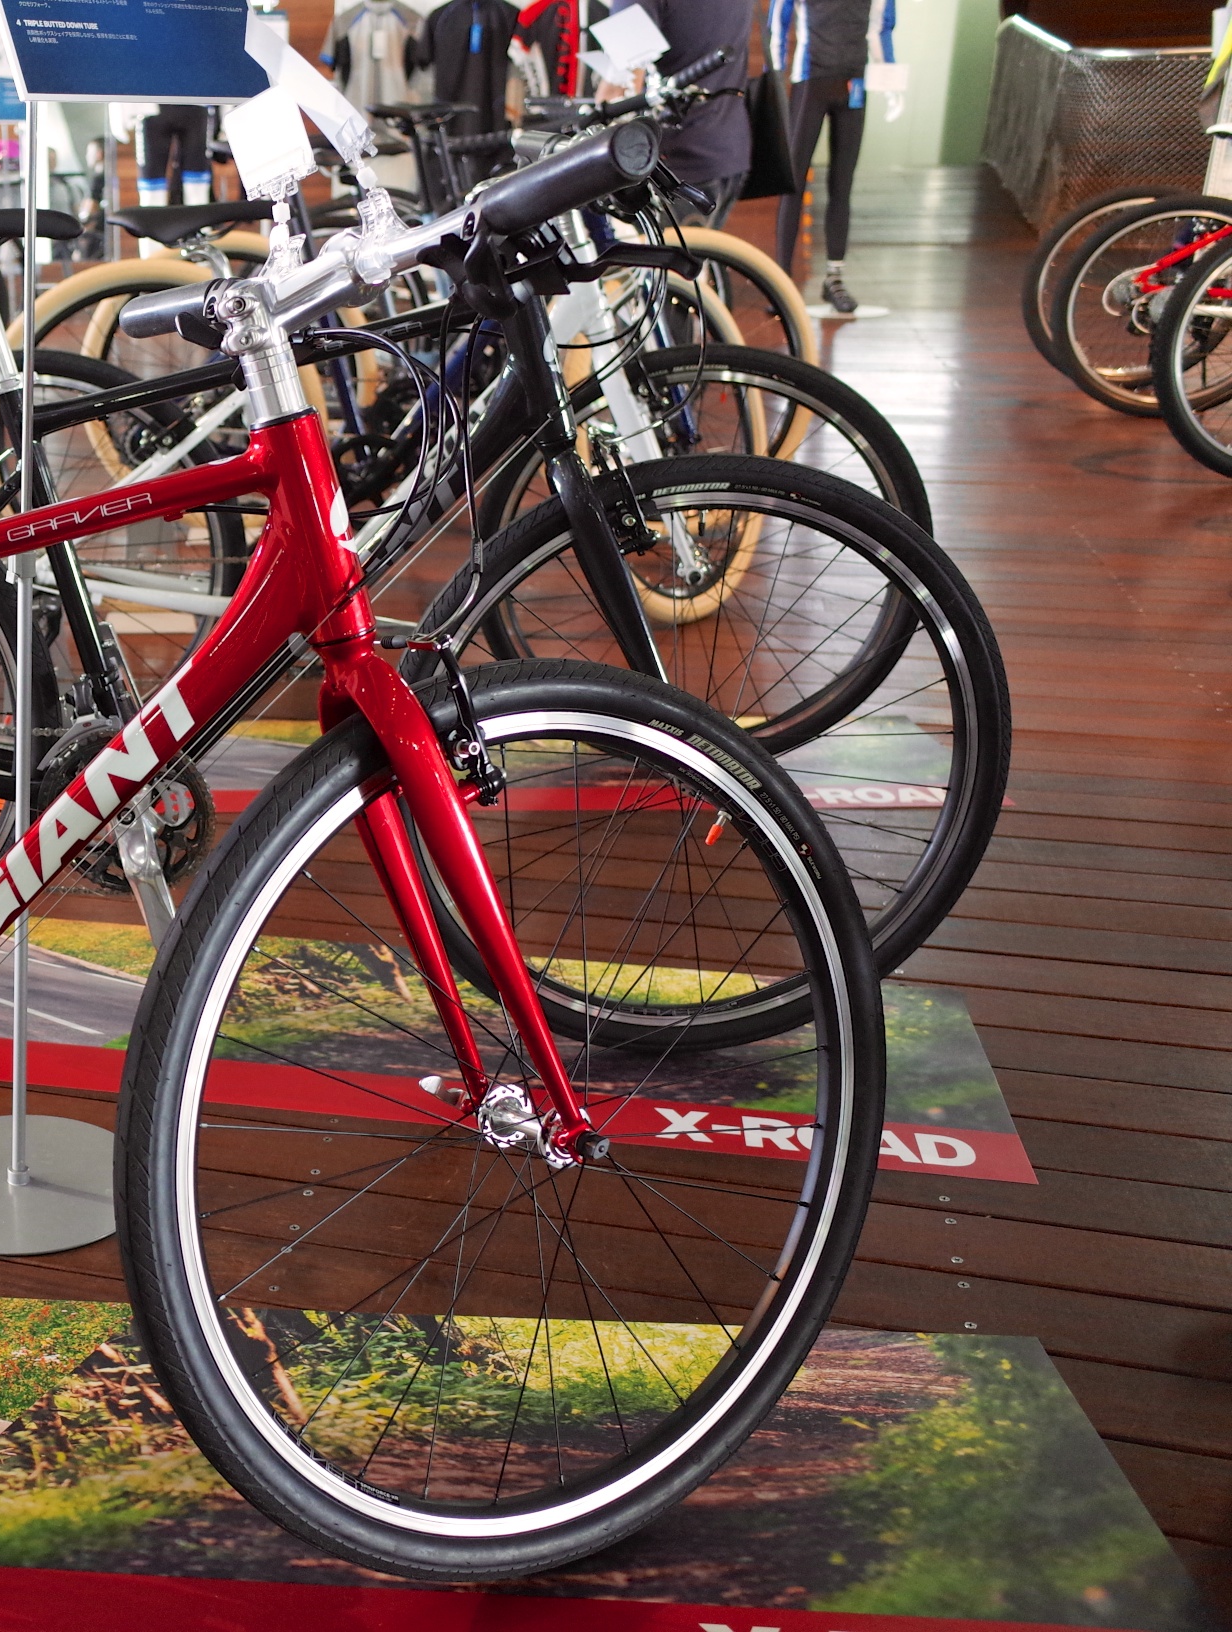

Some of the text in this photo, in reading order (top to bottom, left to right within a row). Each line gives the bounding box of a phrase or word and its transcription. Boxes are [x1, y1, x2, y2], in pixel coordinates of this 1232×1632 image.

[23, 19, 43, 27] TRIPLE
[44, 20, 66, 29] BUTTED
[66, 21, 84, 29] DOWN
[84, 22, 99, 30] TUBE
[652, 481, 731, 497] DETONATOR
[6, 492, 153, 542] GRAVIER
[647, 719, 685, 737] MAXXIS
[686, 733, 763, 791] DETONATOR
[784, 821, 796, 834] MAX
[803, 786, 947, 804] -ROA
[654, 1107, 977, 1167] X-RAD
